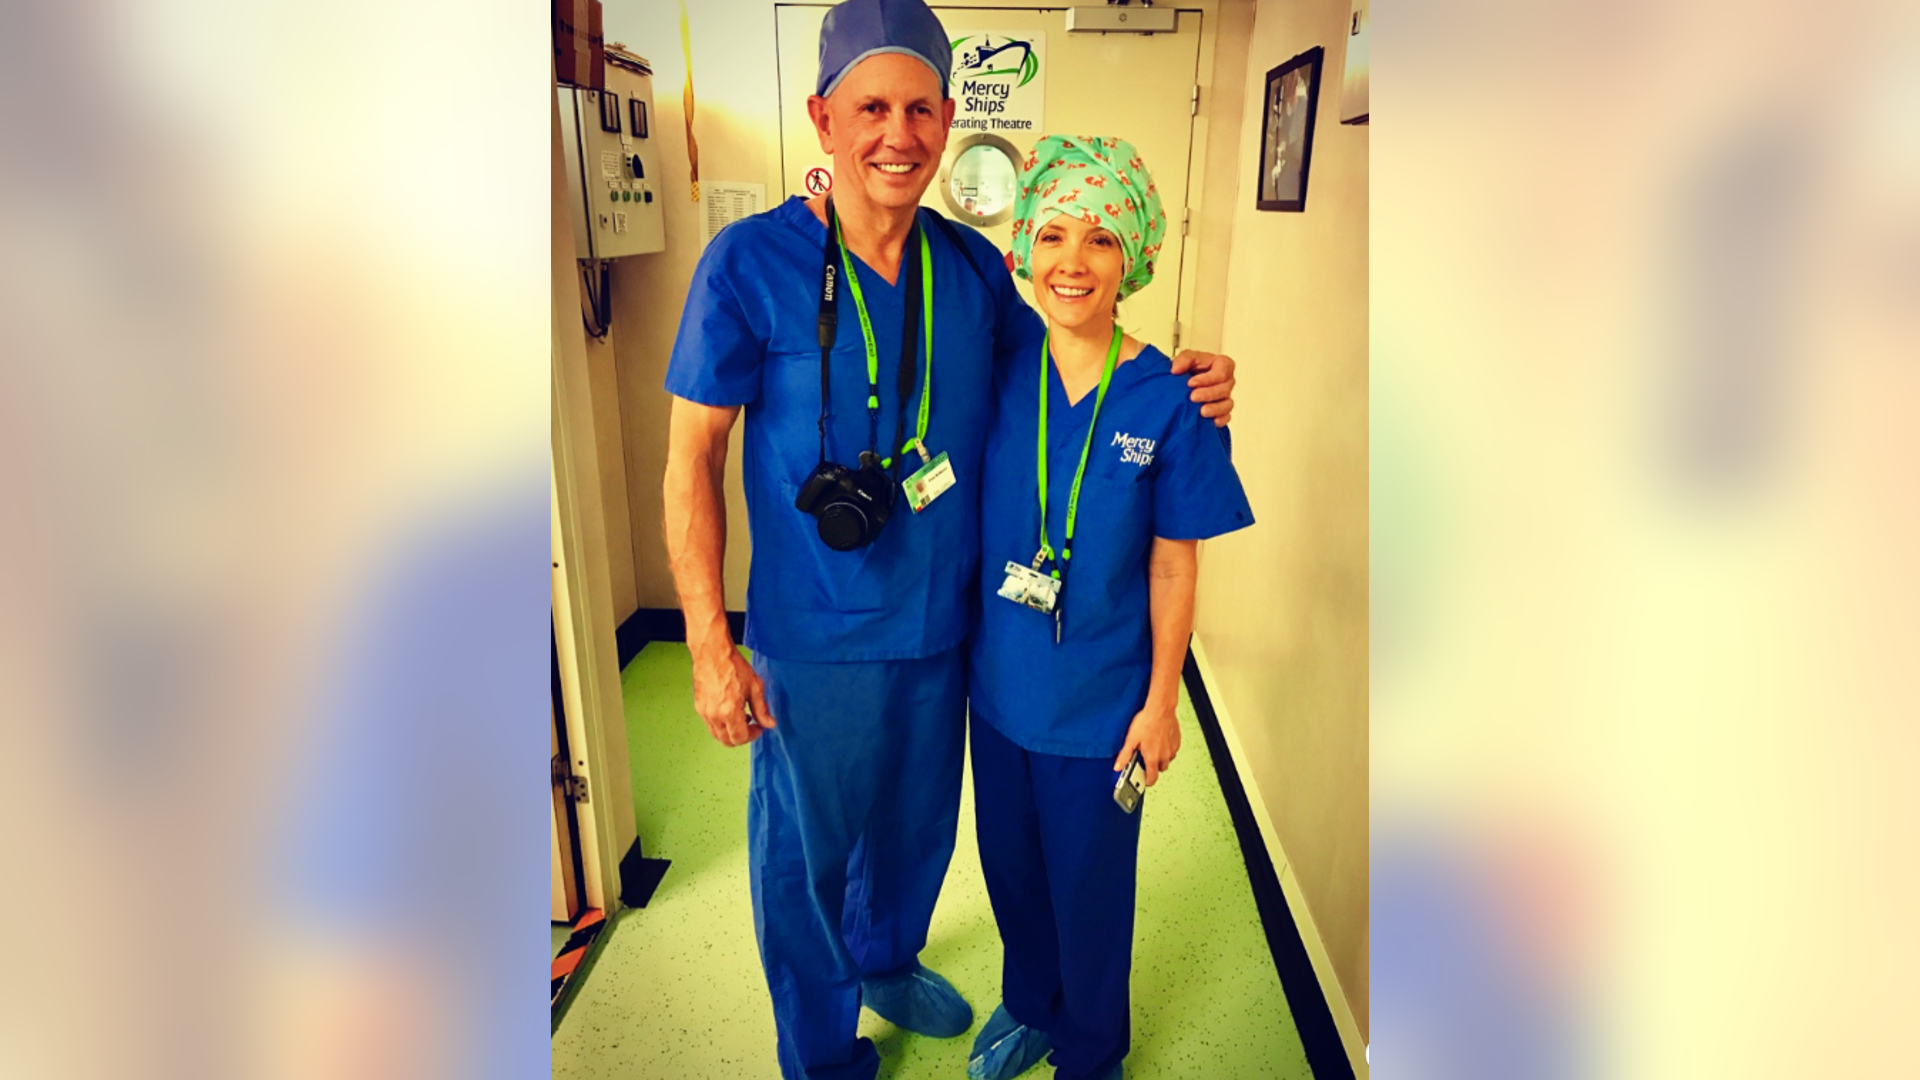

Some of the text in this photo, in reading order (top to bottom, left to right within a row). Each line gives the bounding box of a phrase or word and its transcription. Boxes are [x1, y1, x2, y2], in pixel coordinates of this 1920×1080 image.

[961, 80, 1010, 99] Mercy
[965, 97, 1004, 115] Ships
[950, 117, 1032, 131] erating Theatre
[824, 264, 836, 301] Canon
[1110, 431, 1156, 453] Mercy
